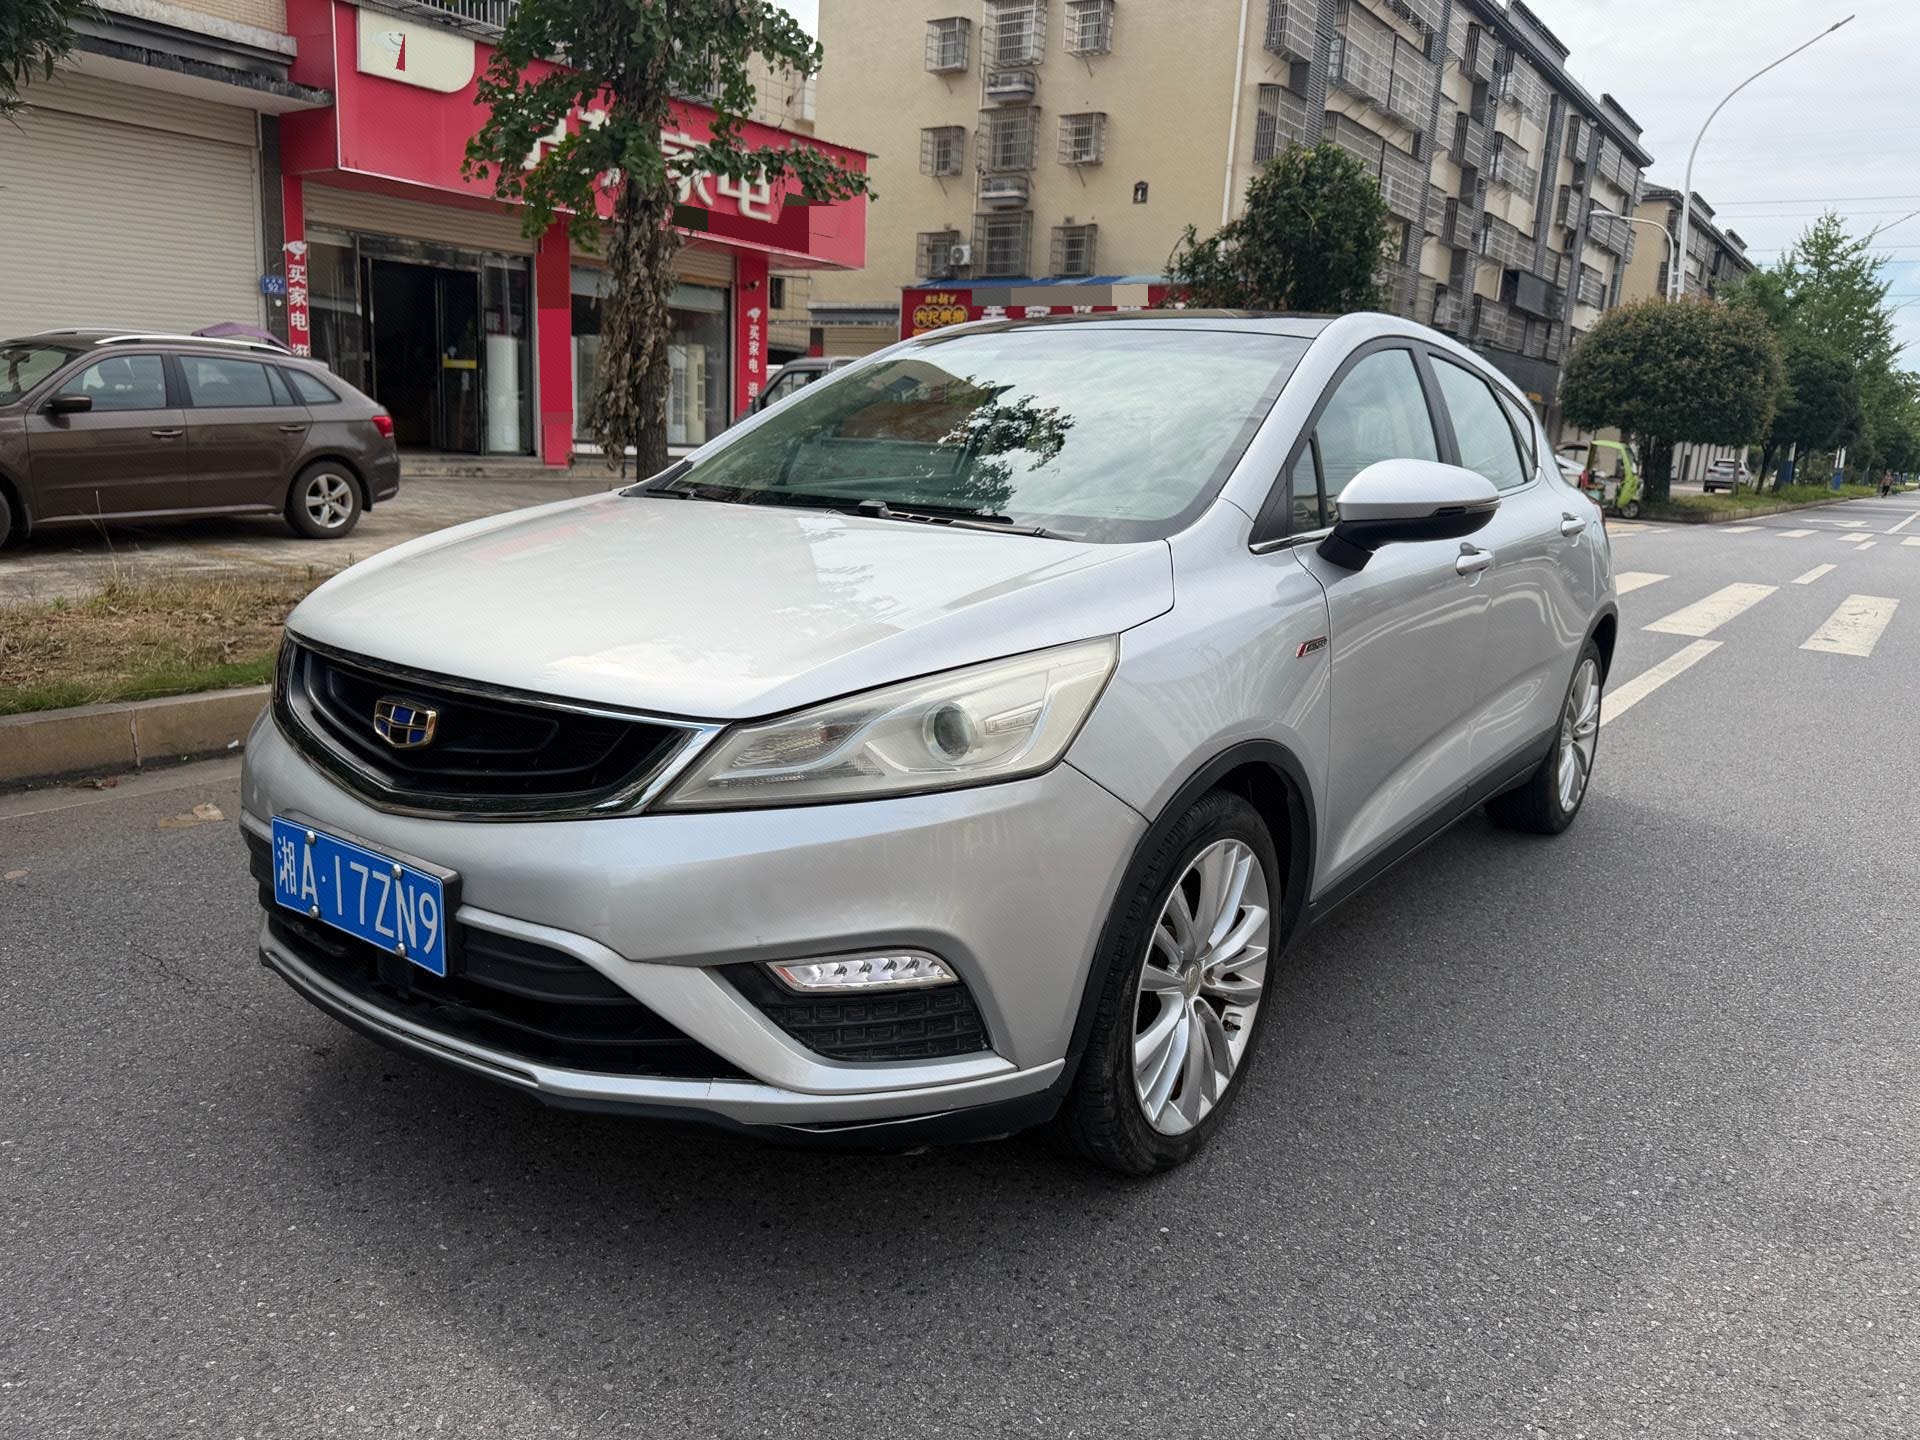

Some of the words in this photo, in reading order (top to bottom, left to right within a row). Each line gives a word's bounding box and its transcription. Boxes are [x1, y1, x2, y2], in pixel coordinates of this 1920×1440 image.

[288, 264, 307, 331] 买家电
[748, 325, 760, 374] 买家电
